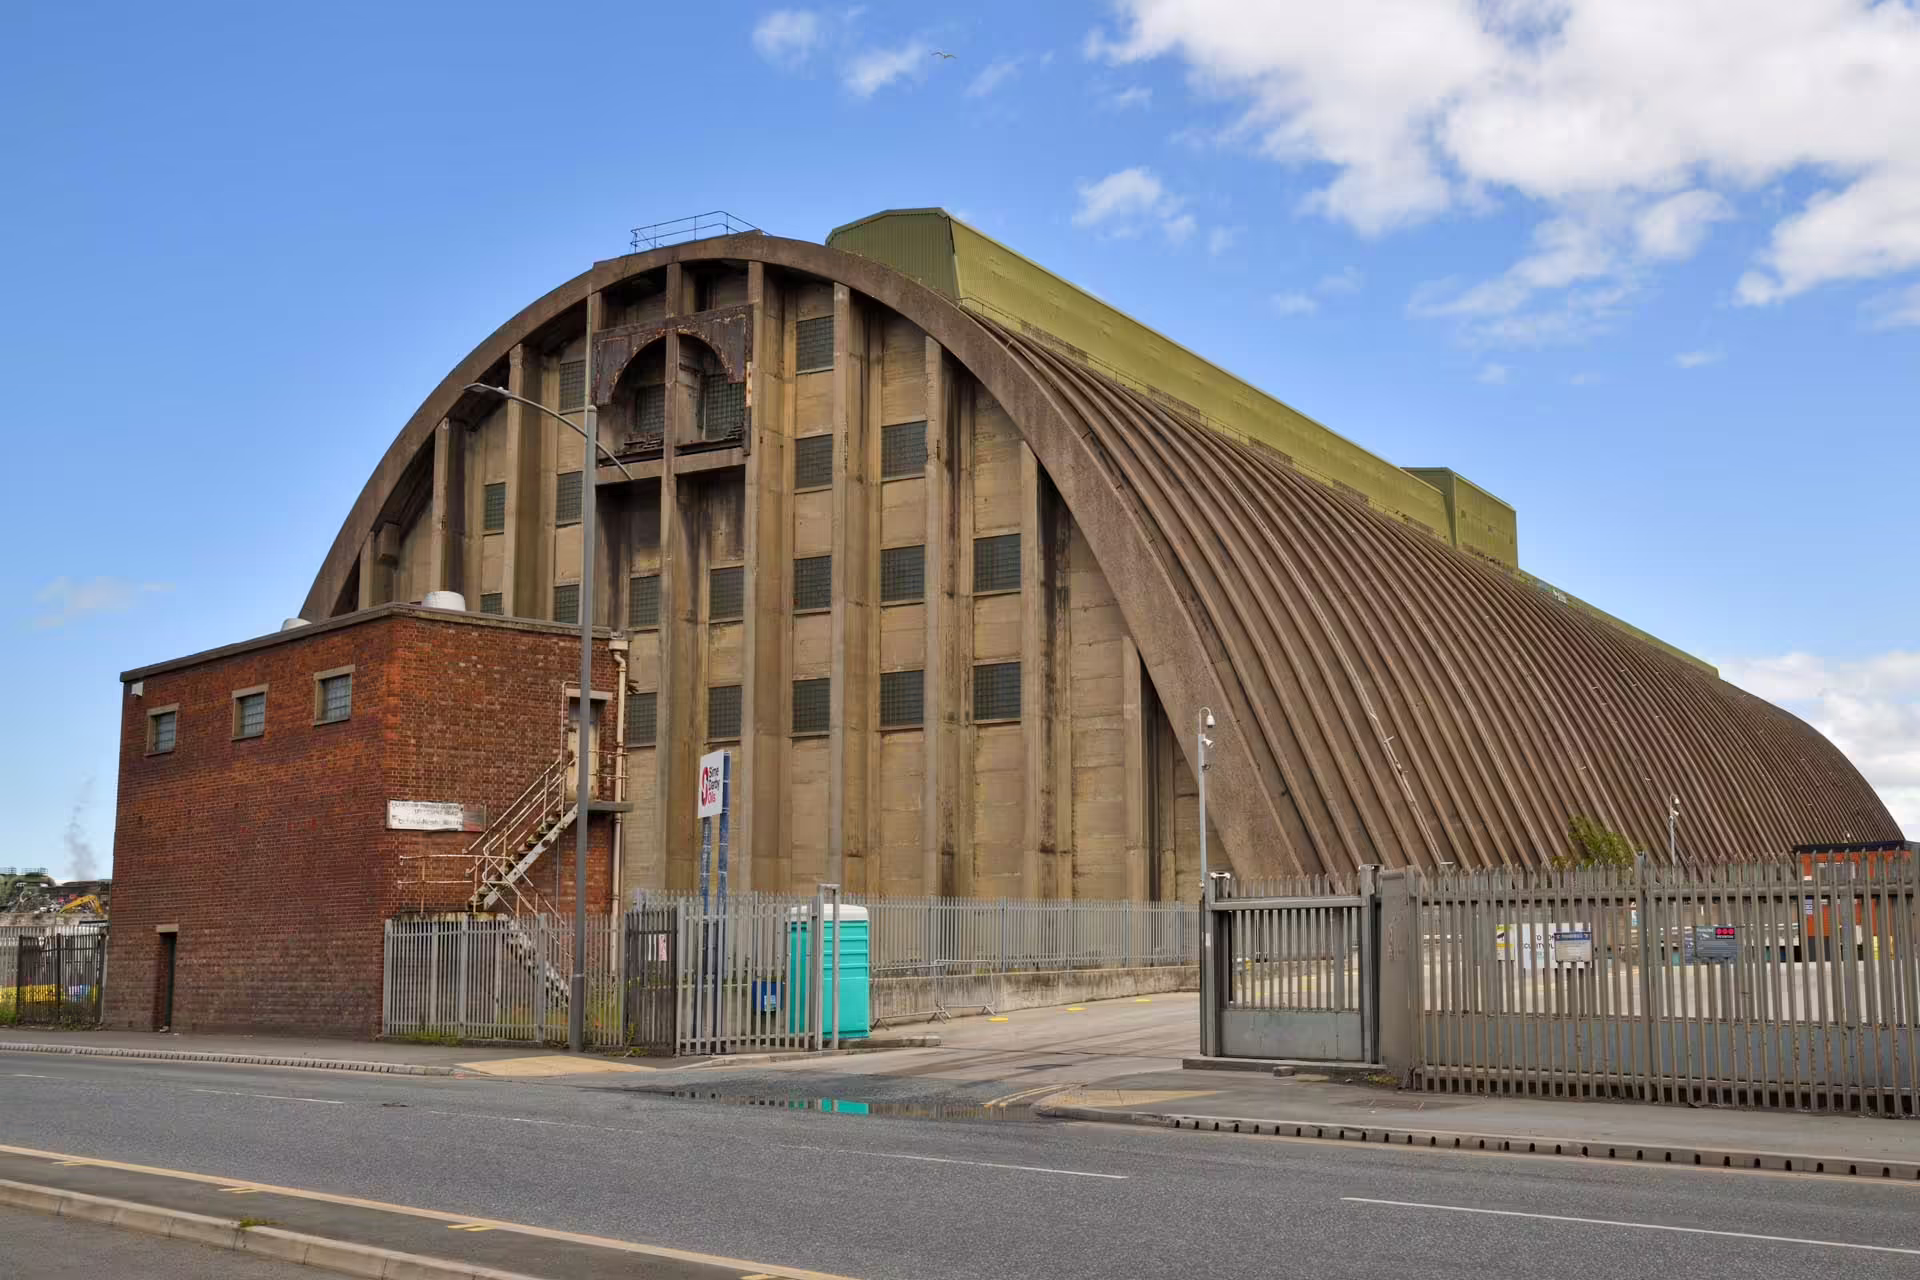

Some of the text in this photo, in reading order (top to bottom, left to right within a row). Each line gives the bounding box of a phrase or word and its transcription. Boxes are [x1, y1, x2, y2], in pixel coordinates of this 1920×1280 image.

[708, 766, 720, 779] Sime
[708, 778, 721, 792] Darby
[707, 791, 717, 805] Oils
